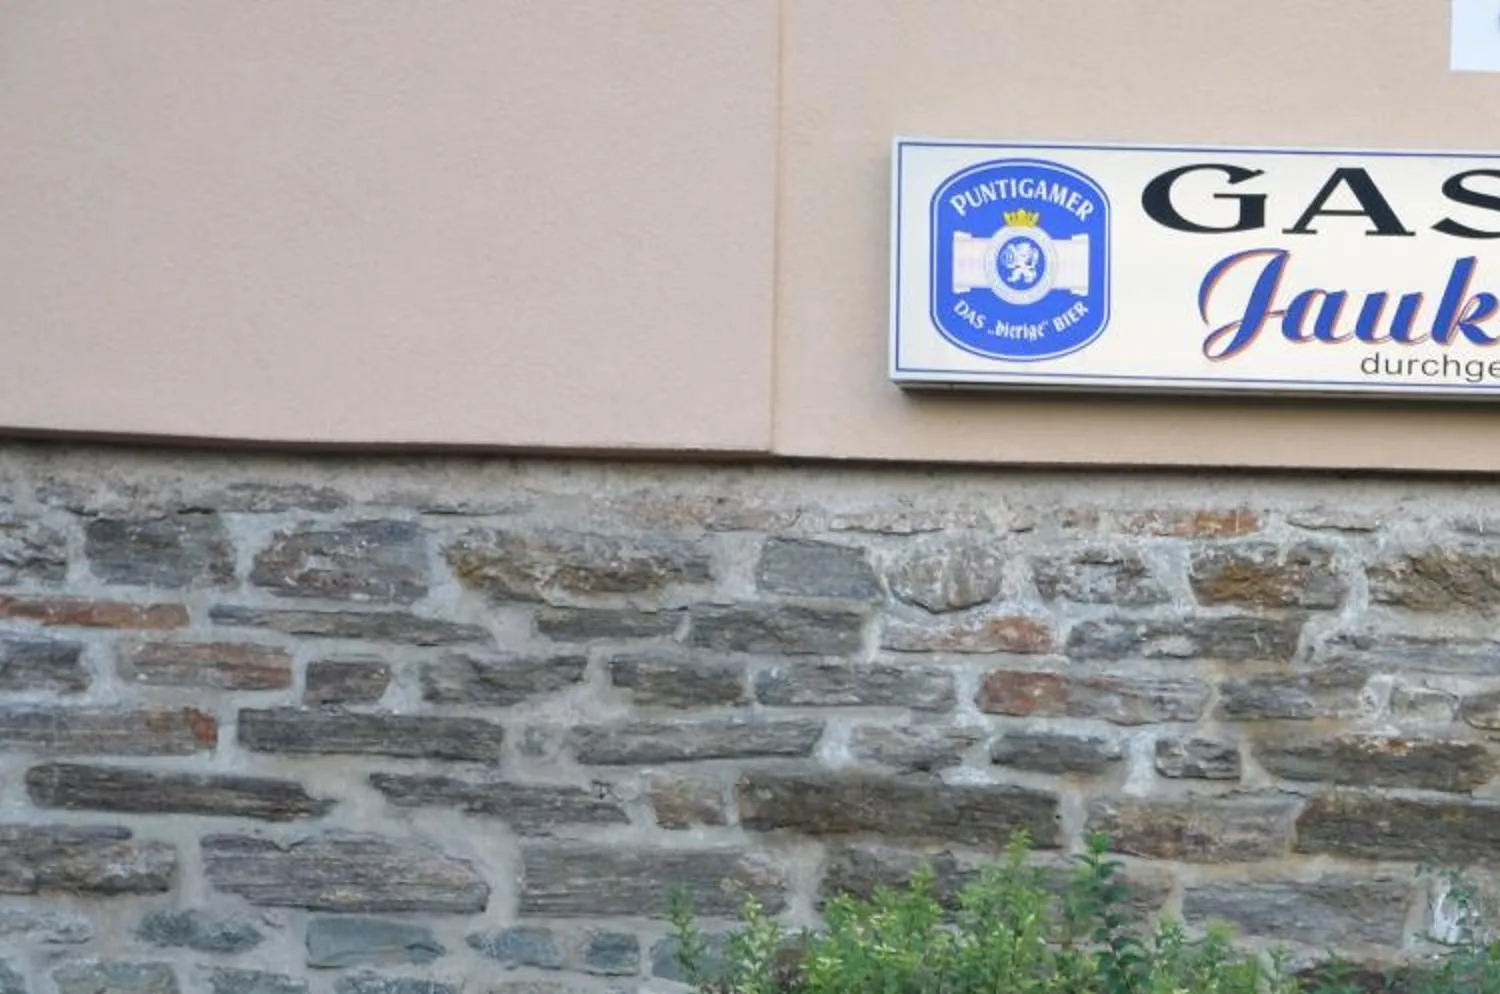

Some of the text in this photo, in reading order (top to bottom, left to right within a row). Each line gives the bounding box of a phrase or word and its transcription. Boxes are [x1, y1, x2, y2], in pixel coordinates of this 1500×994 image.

[950, 179, 1094, 221] PUNTIGAMER
[953, 299, 987, 329] DAS
[1052, 301, 1089, 332] BIER
